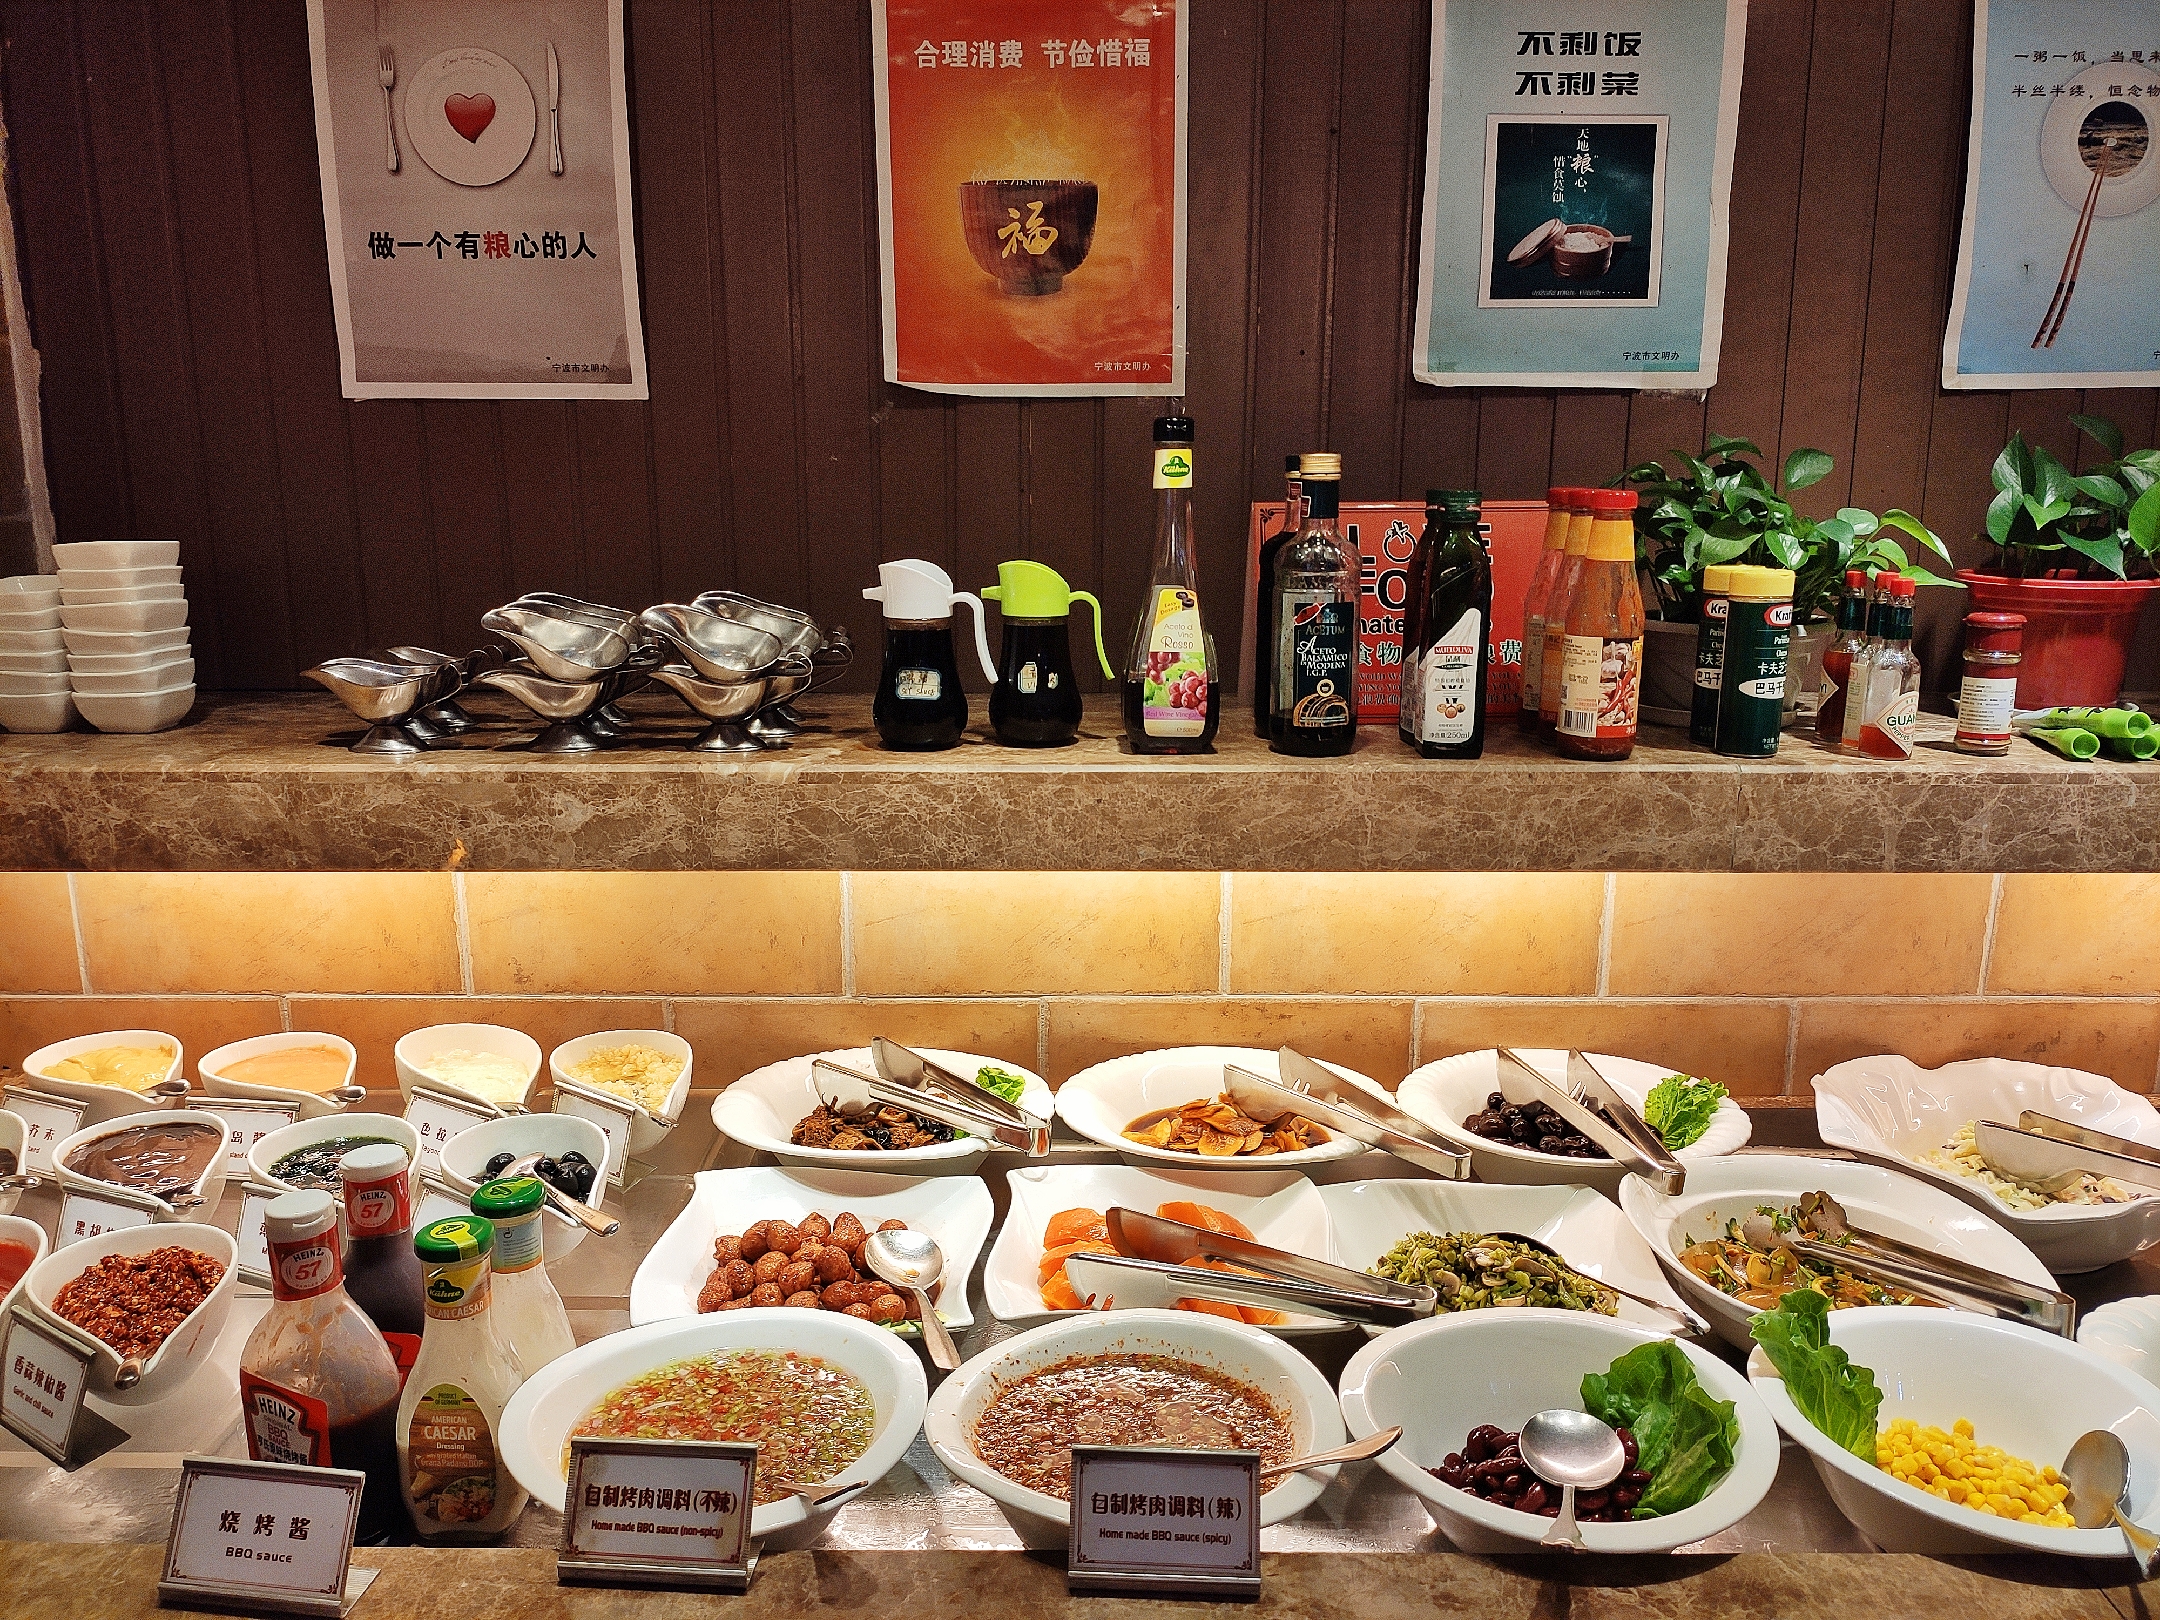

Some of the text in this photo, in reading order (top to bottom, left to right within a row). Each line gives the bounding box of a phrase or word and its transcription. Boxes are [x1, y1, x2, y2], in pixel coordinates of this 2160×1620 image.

[1516, 31, 1642, 57] 不剩饭
[913, 38, 1152, 69] 合理消费 节俭惜福
[1514, 71, 1640, 96] 不剩菜
[997, 200, 1058, 259] 福
[368, 230, 598, 261] 做一个有粮心的人
[1622, 351, 1681, 363] 宁波市文明办
[551, 362, 610, 374] 宁波市文明办
[1094, 360, 1152, 373] 宁波市文明办
[1711, 603, 1728, 615] Kra
[1305, 625, 1347, 636] ACETUM
[1161, 635, 1195, 650] Rosso
[1757, 661, 1787, 676] 卡夫芝
[1755, 682, 1785, 695] 巴马干
[421, 1122, 448, 1142] 色拉
[360, 1191, 387, 1202] HEINZ
[361, 1202, 383, 1219] 57
[293, 1248, 325, 1263] HEINZ
[295, 1260, 322, 1280] 57
[452, 1300, 484, 1318] CAESAR
[13, 1355, 67, 1402] 香蒜辣椒酱
[258, 1397, 296, 1425] HEINZ
[431, 1415, 468, 1424] AMERICAN
[424, 1425, 477, 1441] CAESAR
[436, 1441, 465, 1452] Dressing
[218, 1509, 312, 1541] 烧烤酱
[591, 1519, 724, 1540] Home made BBQ sauce (non-spicy)
[1099, 1528, 1232, 1546] Home made BBQ sauce (spicy)
[225, 1546, 293, 1564] BBQ sauce
